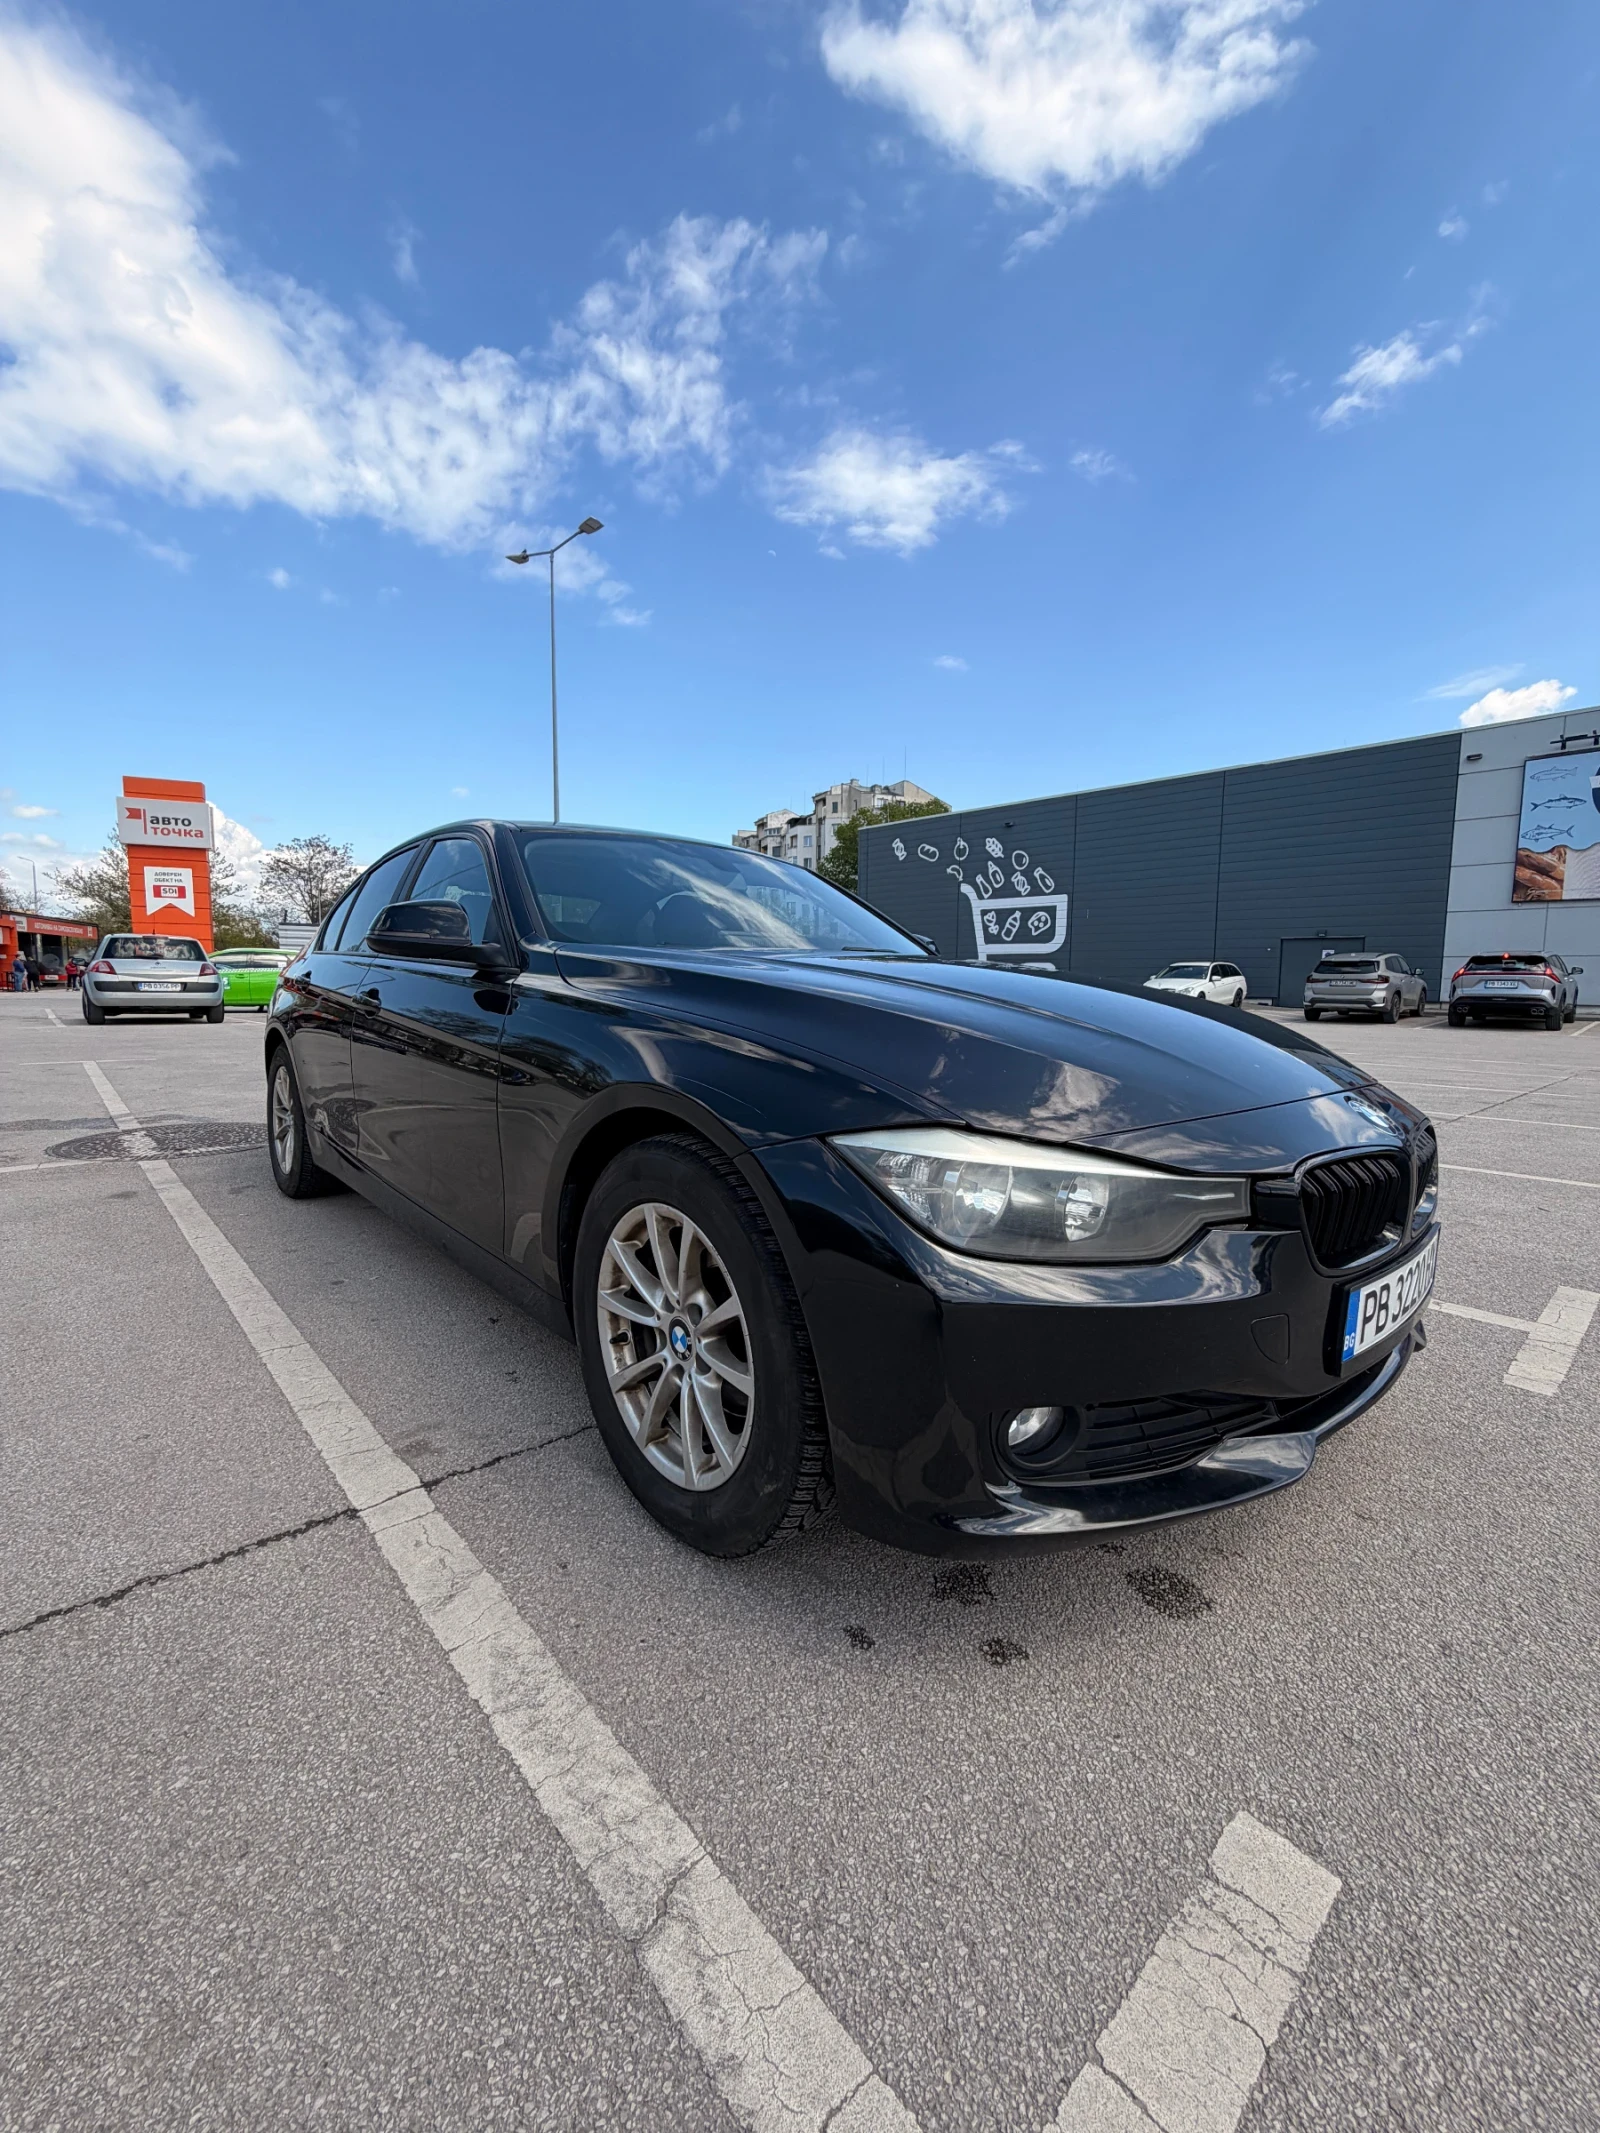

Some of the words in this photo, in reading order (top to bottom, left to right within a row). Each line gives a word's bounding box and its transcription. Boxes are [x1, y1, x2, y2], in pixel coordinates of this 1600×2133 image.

[150, 815, 192, 827] авто
[151, 826, 204, 839] точка
[162, 887, 177, 895] SDI
[1359, 1282, 1391, 1345] PB
[1392, 1253, 1426, 1323] 3220
[1343, 1332, 1355, 1351] BG
